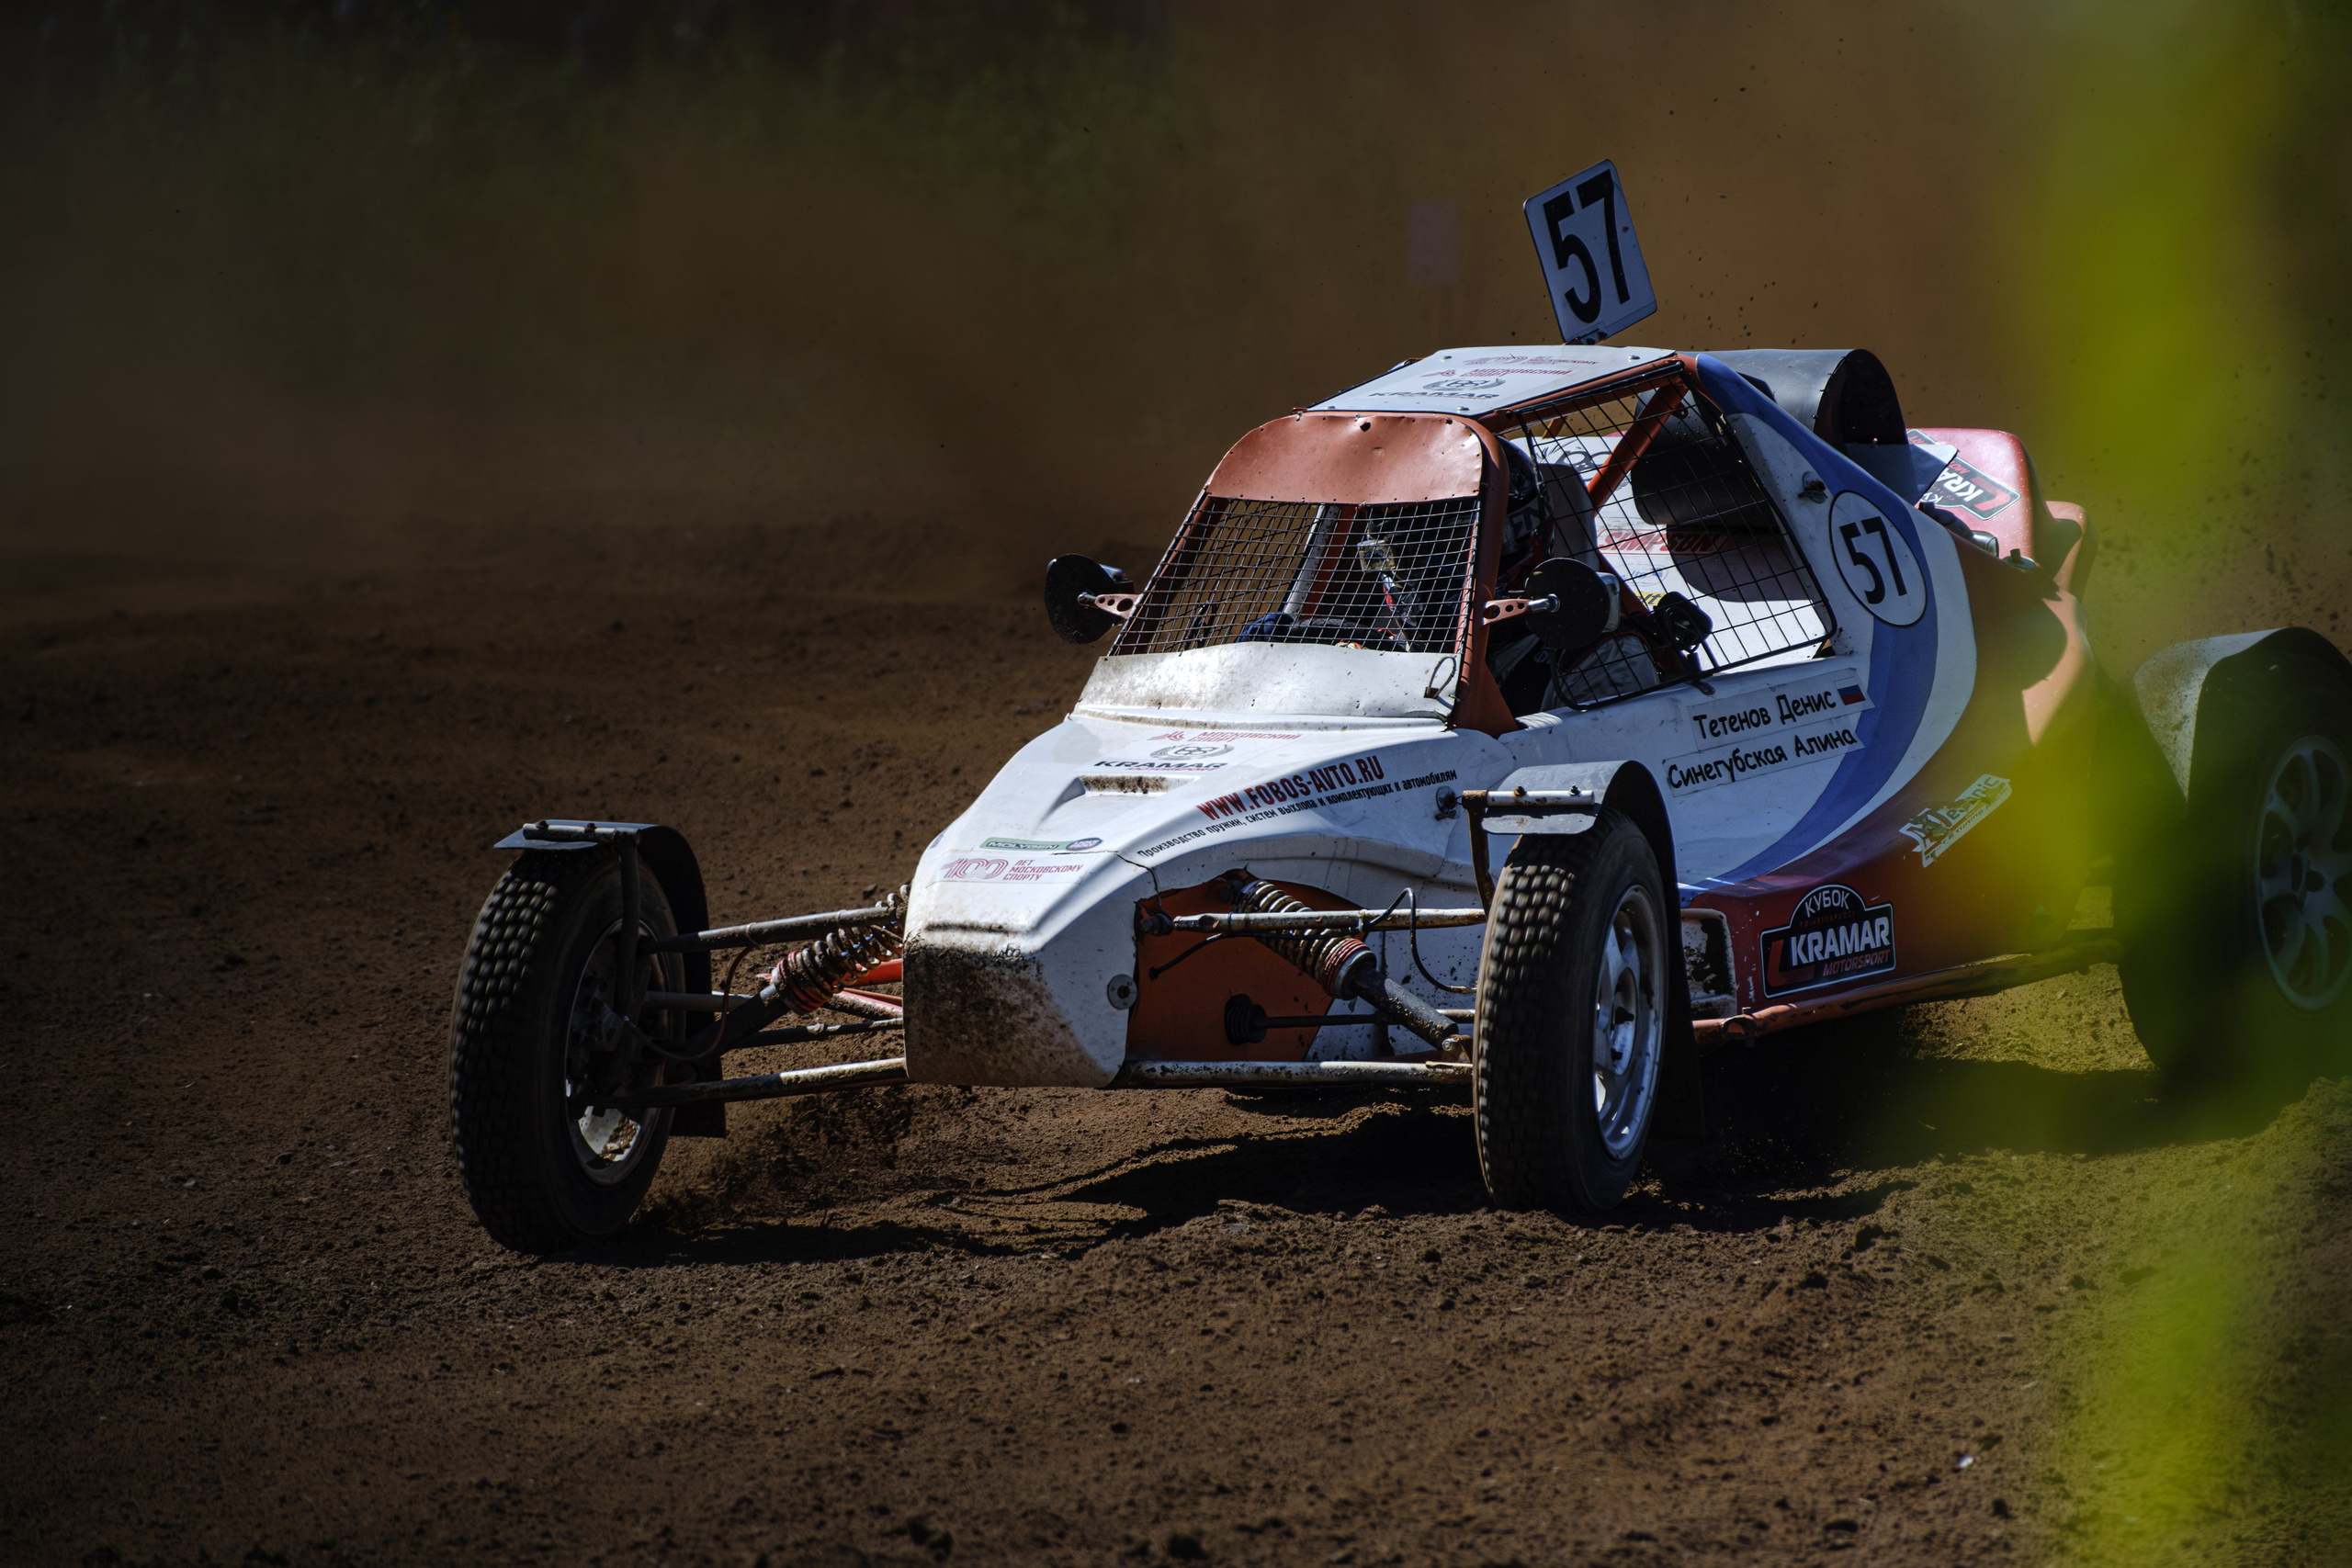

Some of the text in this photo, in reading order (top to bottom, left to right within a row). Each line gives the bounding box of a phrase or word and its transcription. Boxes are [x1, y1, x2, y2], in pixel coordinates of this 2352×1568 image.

[1543, 169, 1631, 324] 57
[1839, 516, 1907, 604] 57
[1693, 691, 1837, 739] Тетенов Денис
[1668, 728, 1858, 789] Синегубская Алина
[1196, 754, 1385, 820] WWW.FOBOS-AVTO.RU
[1136, 829, 1206, 857] Производство
[1205, 818, 1247, 832] пружин,
[1245, 809, 1278, 823] систем
[1277, 798, 1317, 816] выхлопа
[1317, 796, 1327, 807] и
[1325, 782, 1394, 806] комплектующих
[1402, 769, 1458, 791] автомобилям
[939, 858, 1009, 880] 100
[1009, 864, 1084, 873] МОСКОВСКОМУ
[1805, 889, 1850, 918] КУБОК
[1791, 916, 1891, 966] KRAMAR
[1823, 948, 1891, 976] MOTORSPORT
